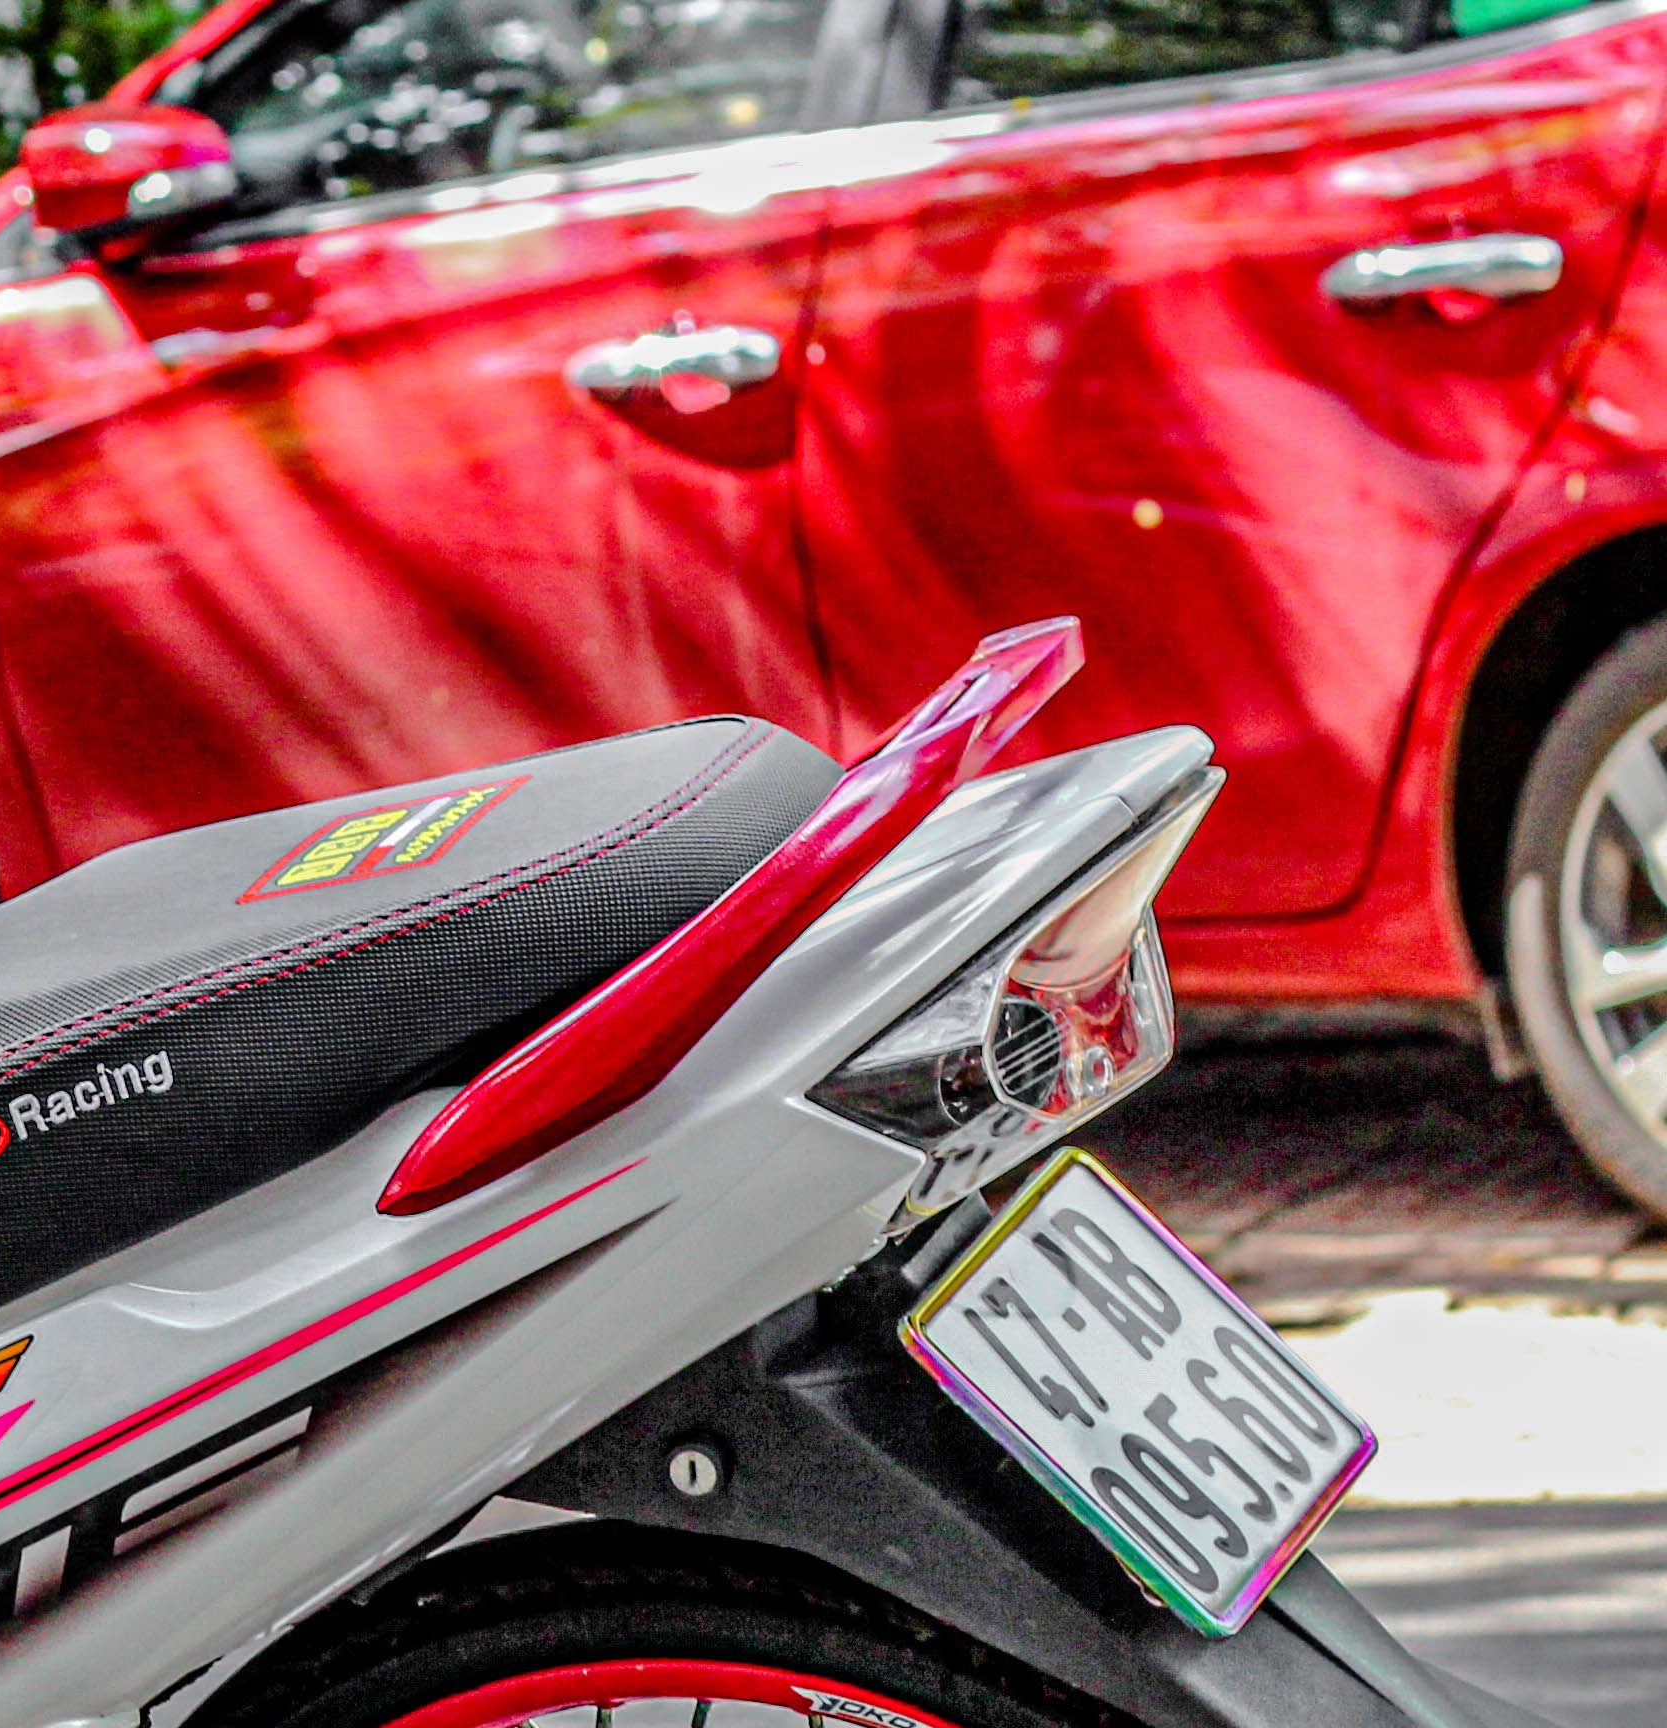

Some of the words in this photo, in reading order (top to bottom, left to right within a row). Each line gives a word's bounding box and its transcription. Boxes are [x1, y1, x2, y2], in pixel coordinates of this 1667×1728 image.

[9, 1051, 175, 1140] Racing
[963, 1207, 1183, 1428] 47-AB
[1091, 1326, 1336, 1593] 095.60
